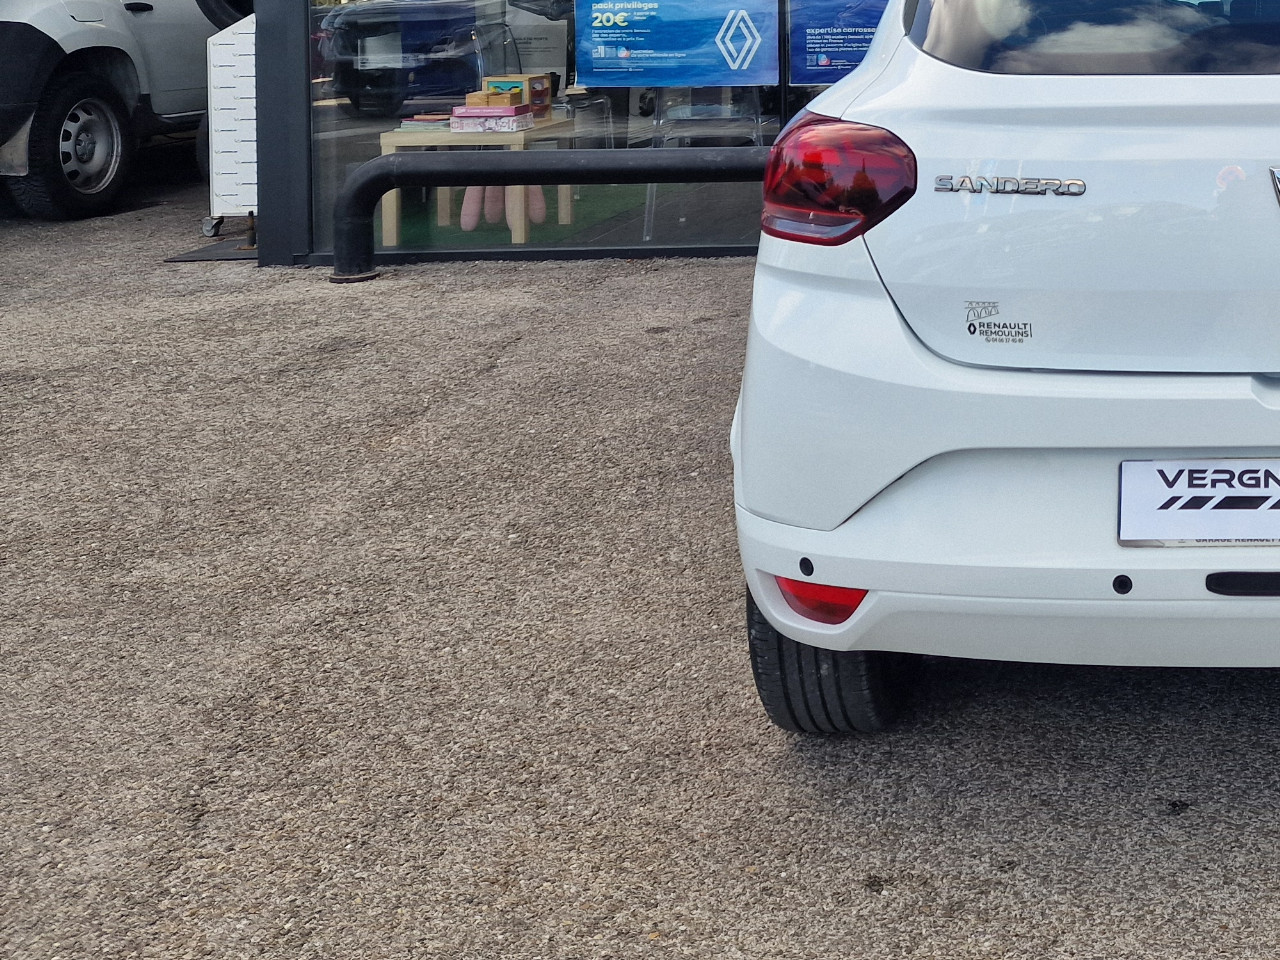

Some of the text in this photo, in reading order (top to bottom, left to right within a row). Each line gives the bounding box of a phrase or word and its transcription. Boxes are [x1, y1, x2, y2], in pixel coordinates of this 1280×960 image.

[592, 1, 659, 10] pack privilèges
[806, 26, 842, 34] expertise
[934, 174, 1087, 196] SANDERO
[979, 322, 1029, 330] RENAULT
[979, 329, 1029, 338] REMOULINS
